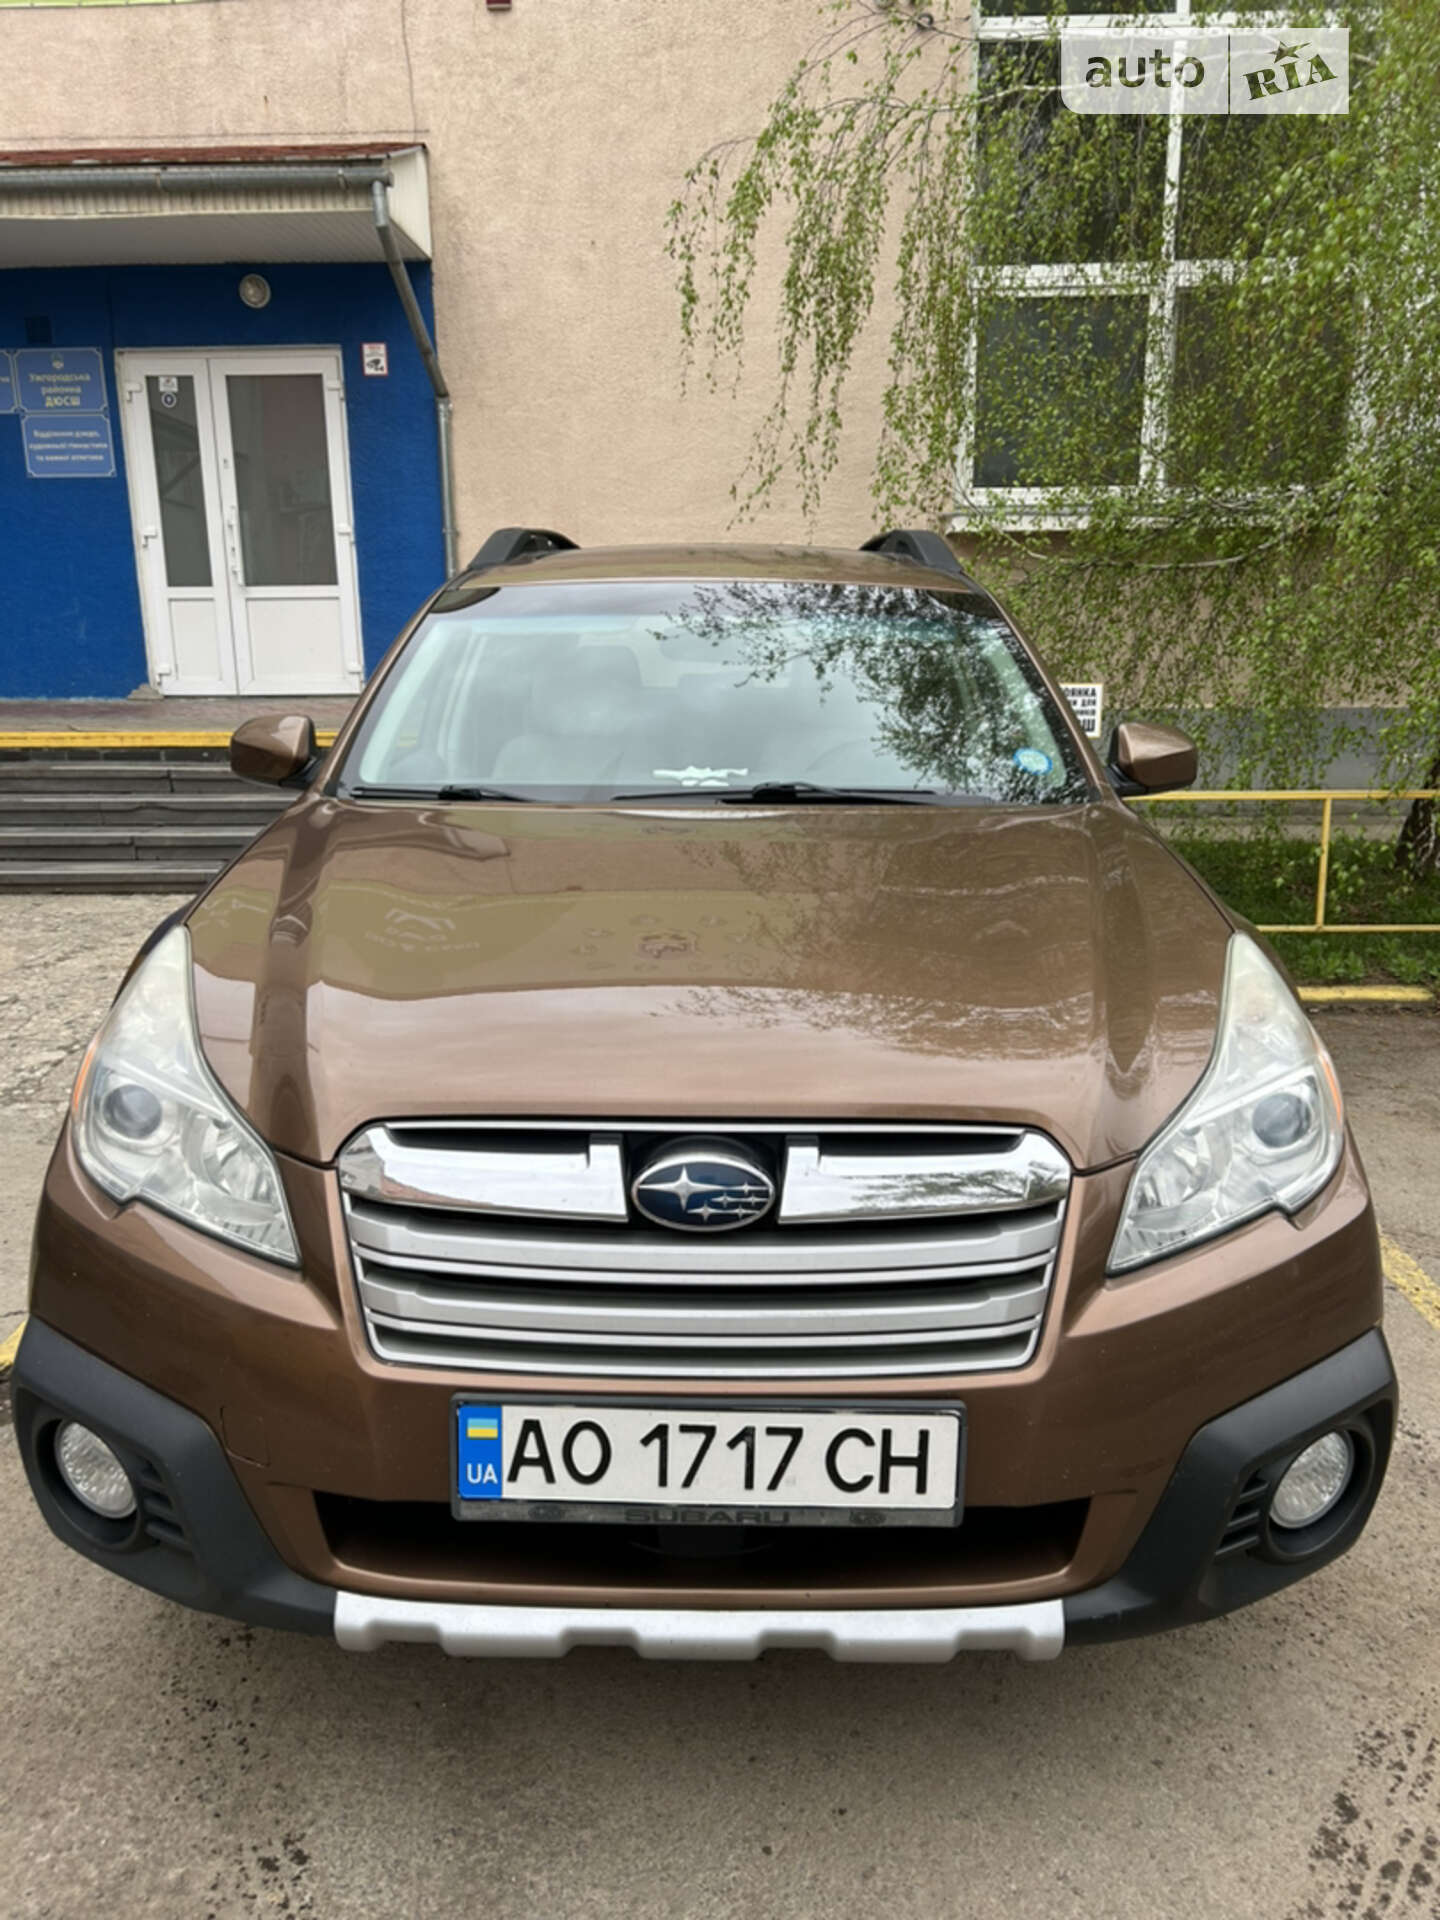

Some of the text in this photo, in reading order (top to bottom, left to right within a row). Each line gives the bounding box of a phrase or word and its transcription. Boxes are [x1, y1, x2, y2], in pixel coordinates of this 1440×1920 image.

[45, 395, 81, 408] ДЮСШ
[507, 1418, 930, 1494] AO 1717 CH
[466, 1463, 498, 1485] UA
[624, 1508, 791, 1524] SUBARU
